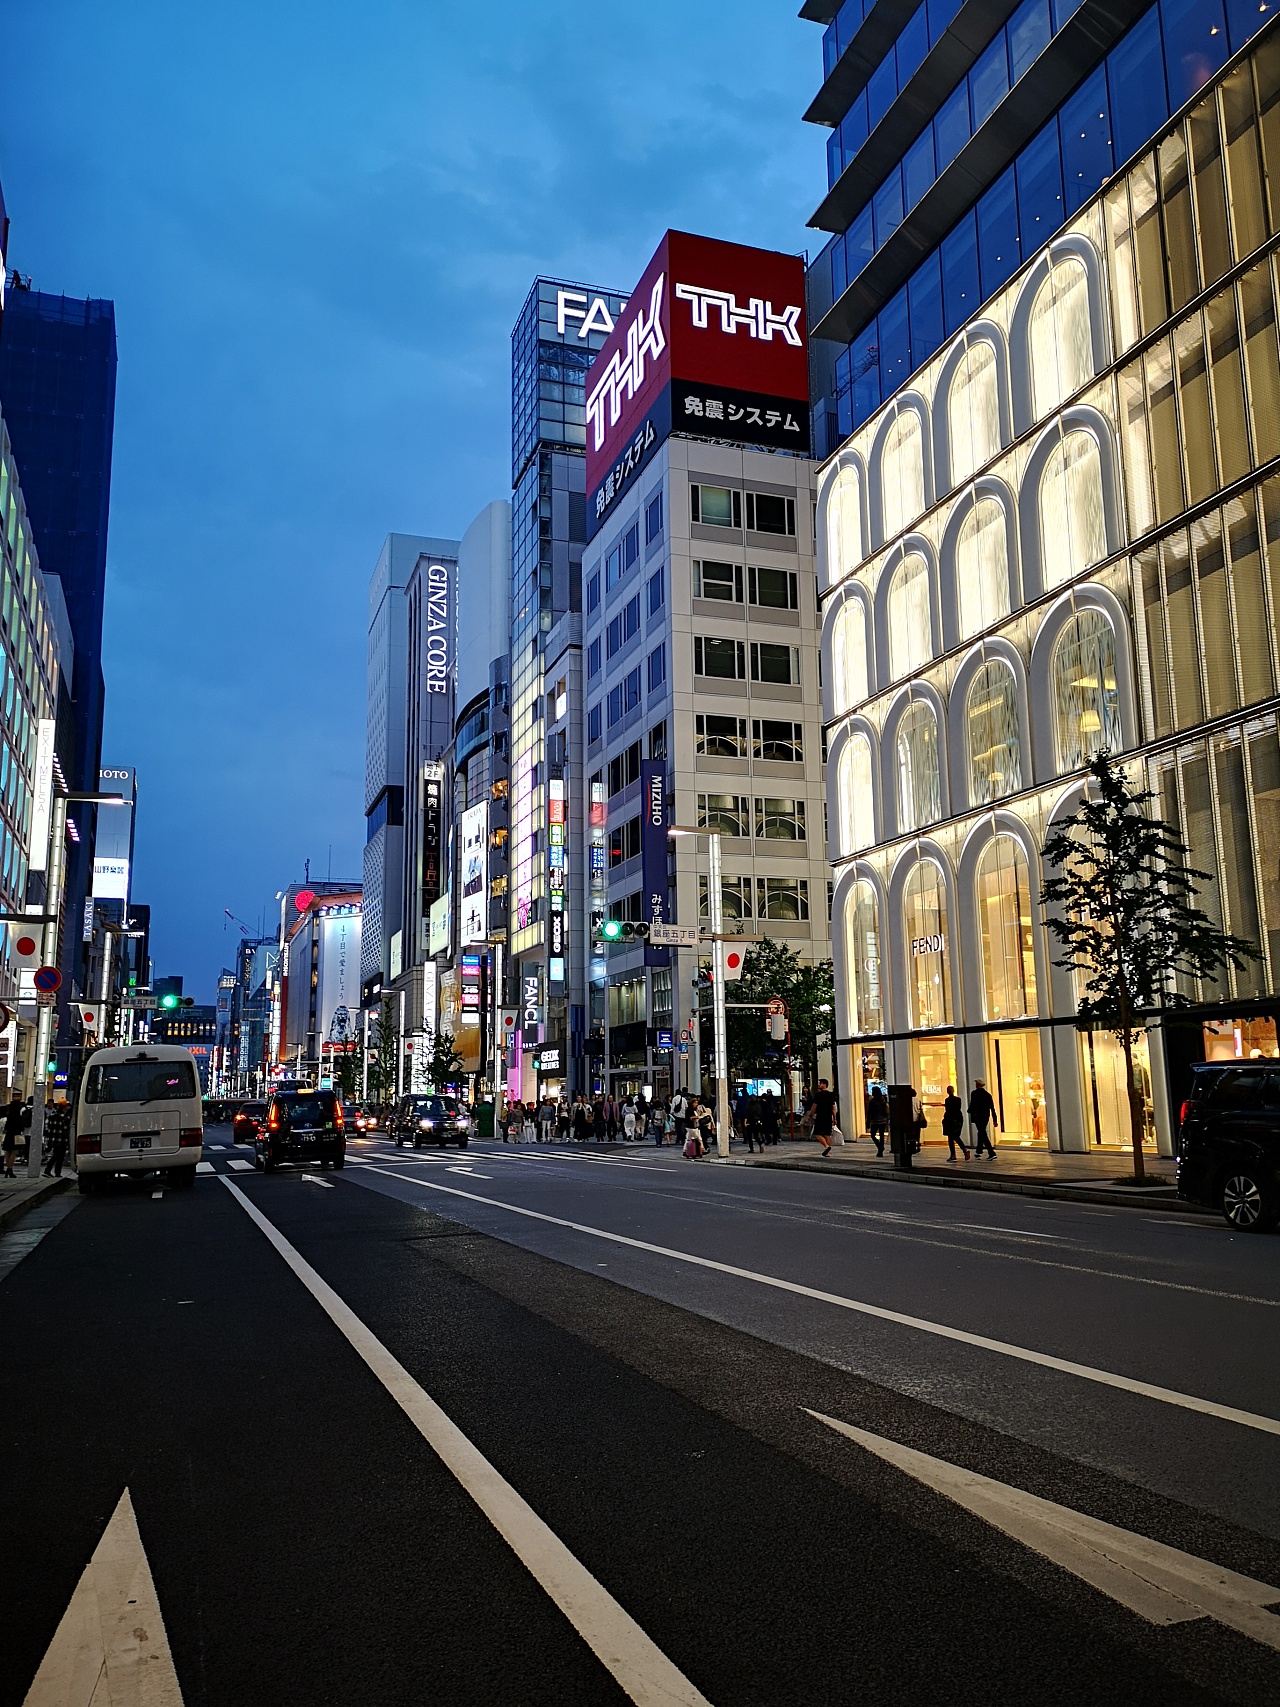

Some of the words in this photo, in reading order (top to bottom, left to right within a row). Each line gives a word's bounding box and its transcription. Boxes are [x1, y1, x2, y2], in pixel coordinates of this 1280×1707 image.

[557, 290, 627, 338] FA
[675, 282, 803, 347] THK
[586, 271, 667, 452] THK
[684, 395, 801, 432] 免震システム
[595, 419, 656, 519] 免震システム
[427, 565, 448, 632] GINZA
[427, 635, 447, 693] CORE
[99, 769, 129, 780] OTO
[651, 775, 663, 826] MIZUHO
[84, 901, 93, 938] TASAKI
[653, 929, 695, 938] 銀座五丁目
[911, 933, 945, 956] FENDI
[524, 976, 538, 1030] FANCL
